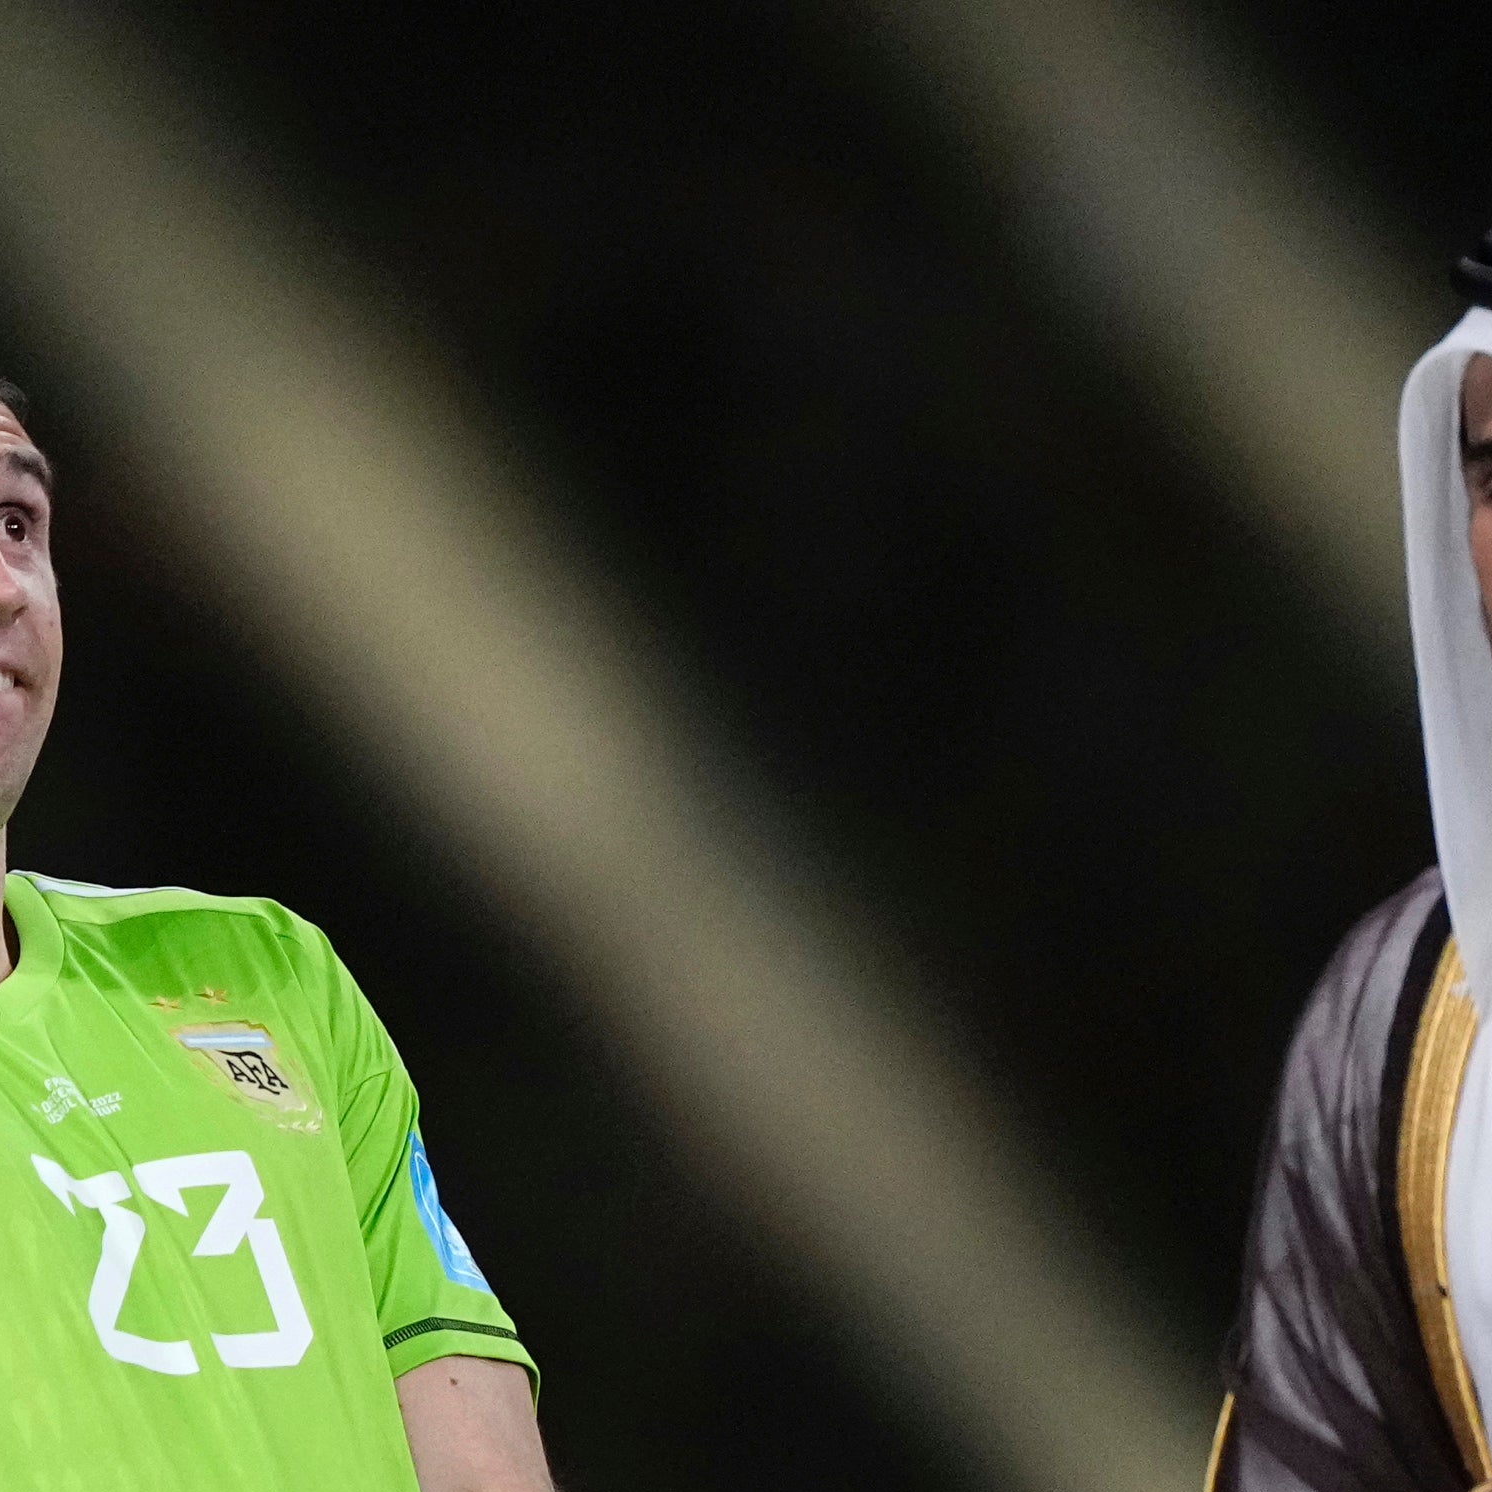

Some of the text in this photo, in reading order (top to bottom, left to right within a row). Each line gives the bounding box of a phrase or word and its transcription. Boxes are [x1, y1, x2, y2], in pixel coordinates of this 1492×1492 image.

[216, 1049, 288, 1096] AFA
[89, 1091, 122, 1108] 2022
[30, 1149, 314, 1376] 23
